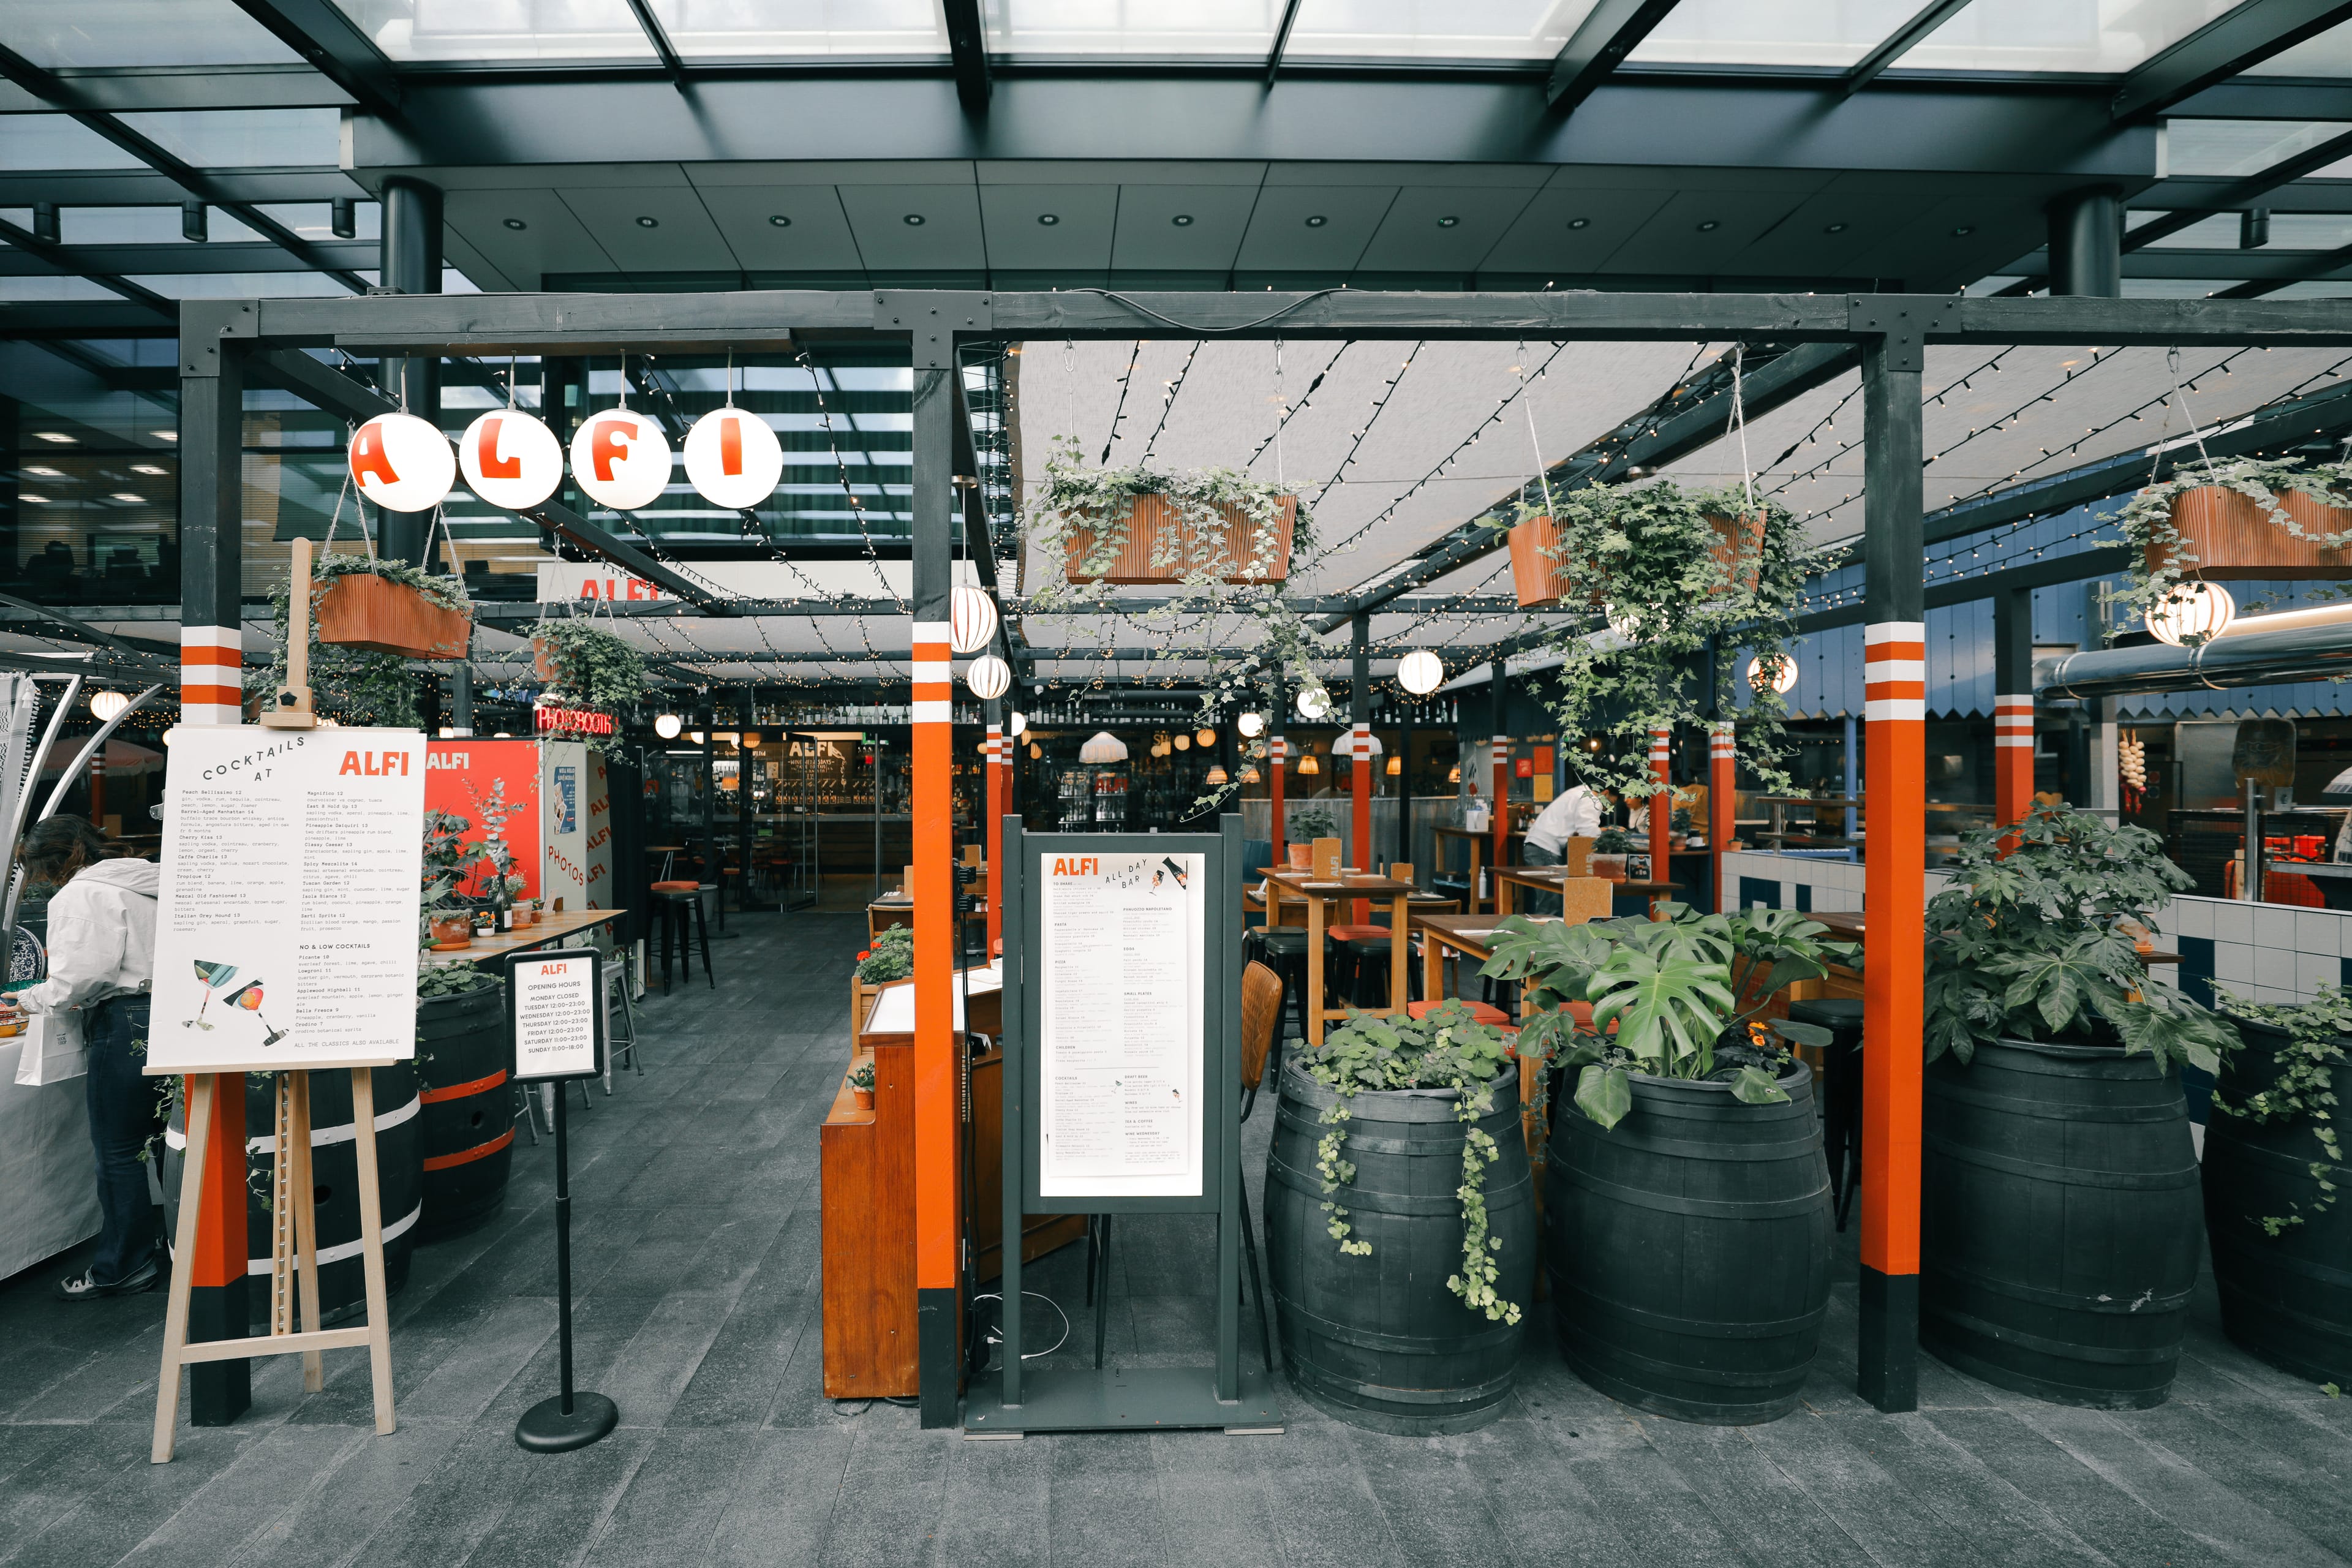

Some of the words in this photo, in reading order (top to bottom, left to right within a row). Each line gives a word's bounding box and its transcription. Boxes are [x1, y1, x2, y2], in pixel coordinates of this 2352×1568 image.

[351, 418, 742, 487] ALFI
[202, 737, 304, 780] COCKTAILS
[339, 751, 409, 776] ALFI
[426, 753, 469, 769] ALFI
[254, 768, 272, 782] AT
[548, 846, 583, 887] PHOTOS
[1053, 858, 1098, 876] ALFI
[1106, 871, 1122, 883] ALL
[1129, 859, 1147, 872] DAY
[1122, 876, 1139, 888] BAR
[541, 964, 567, 975] ALFI
